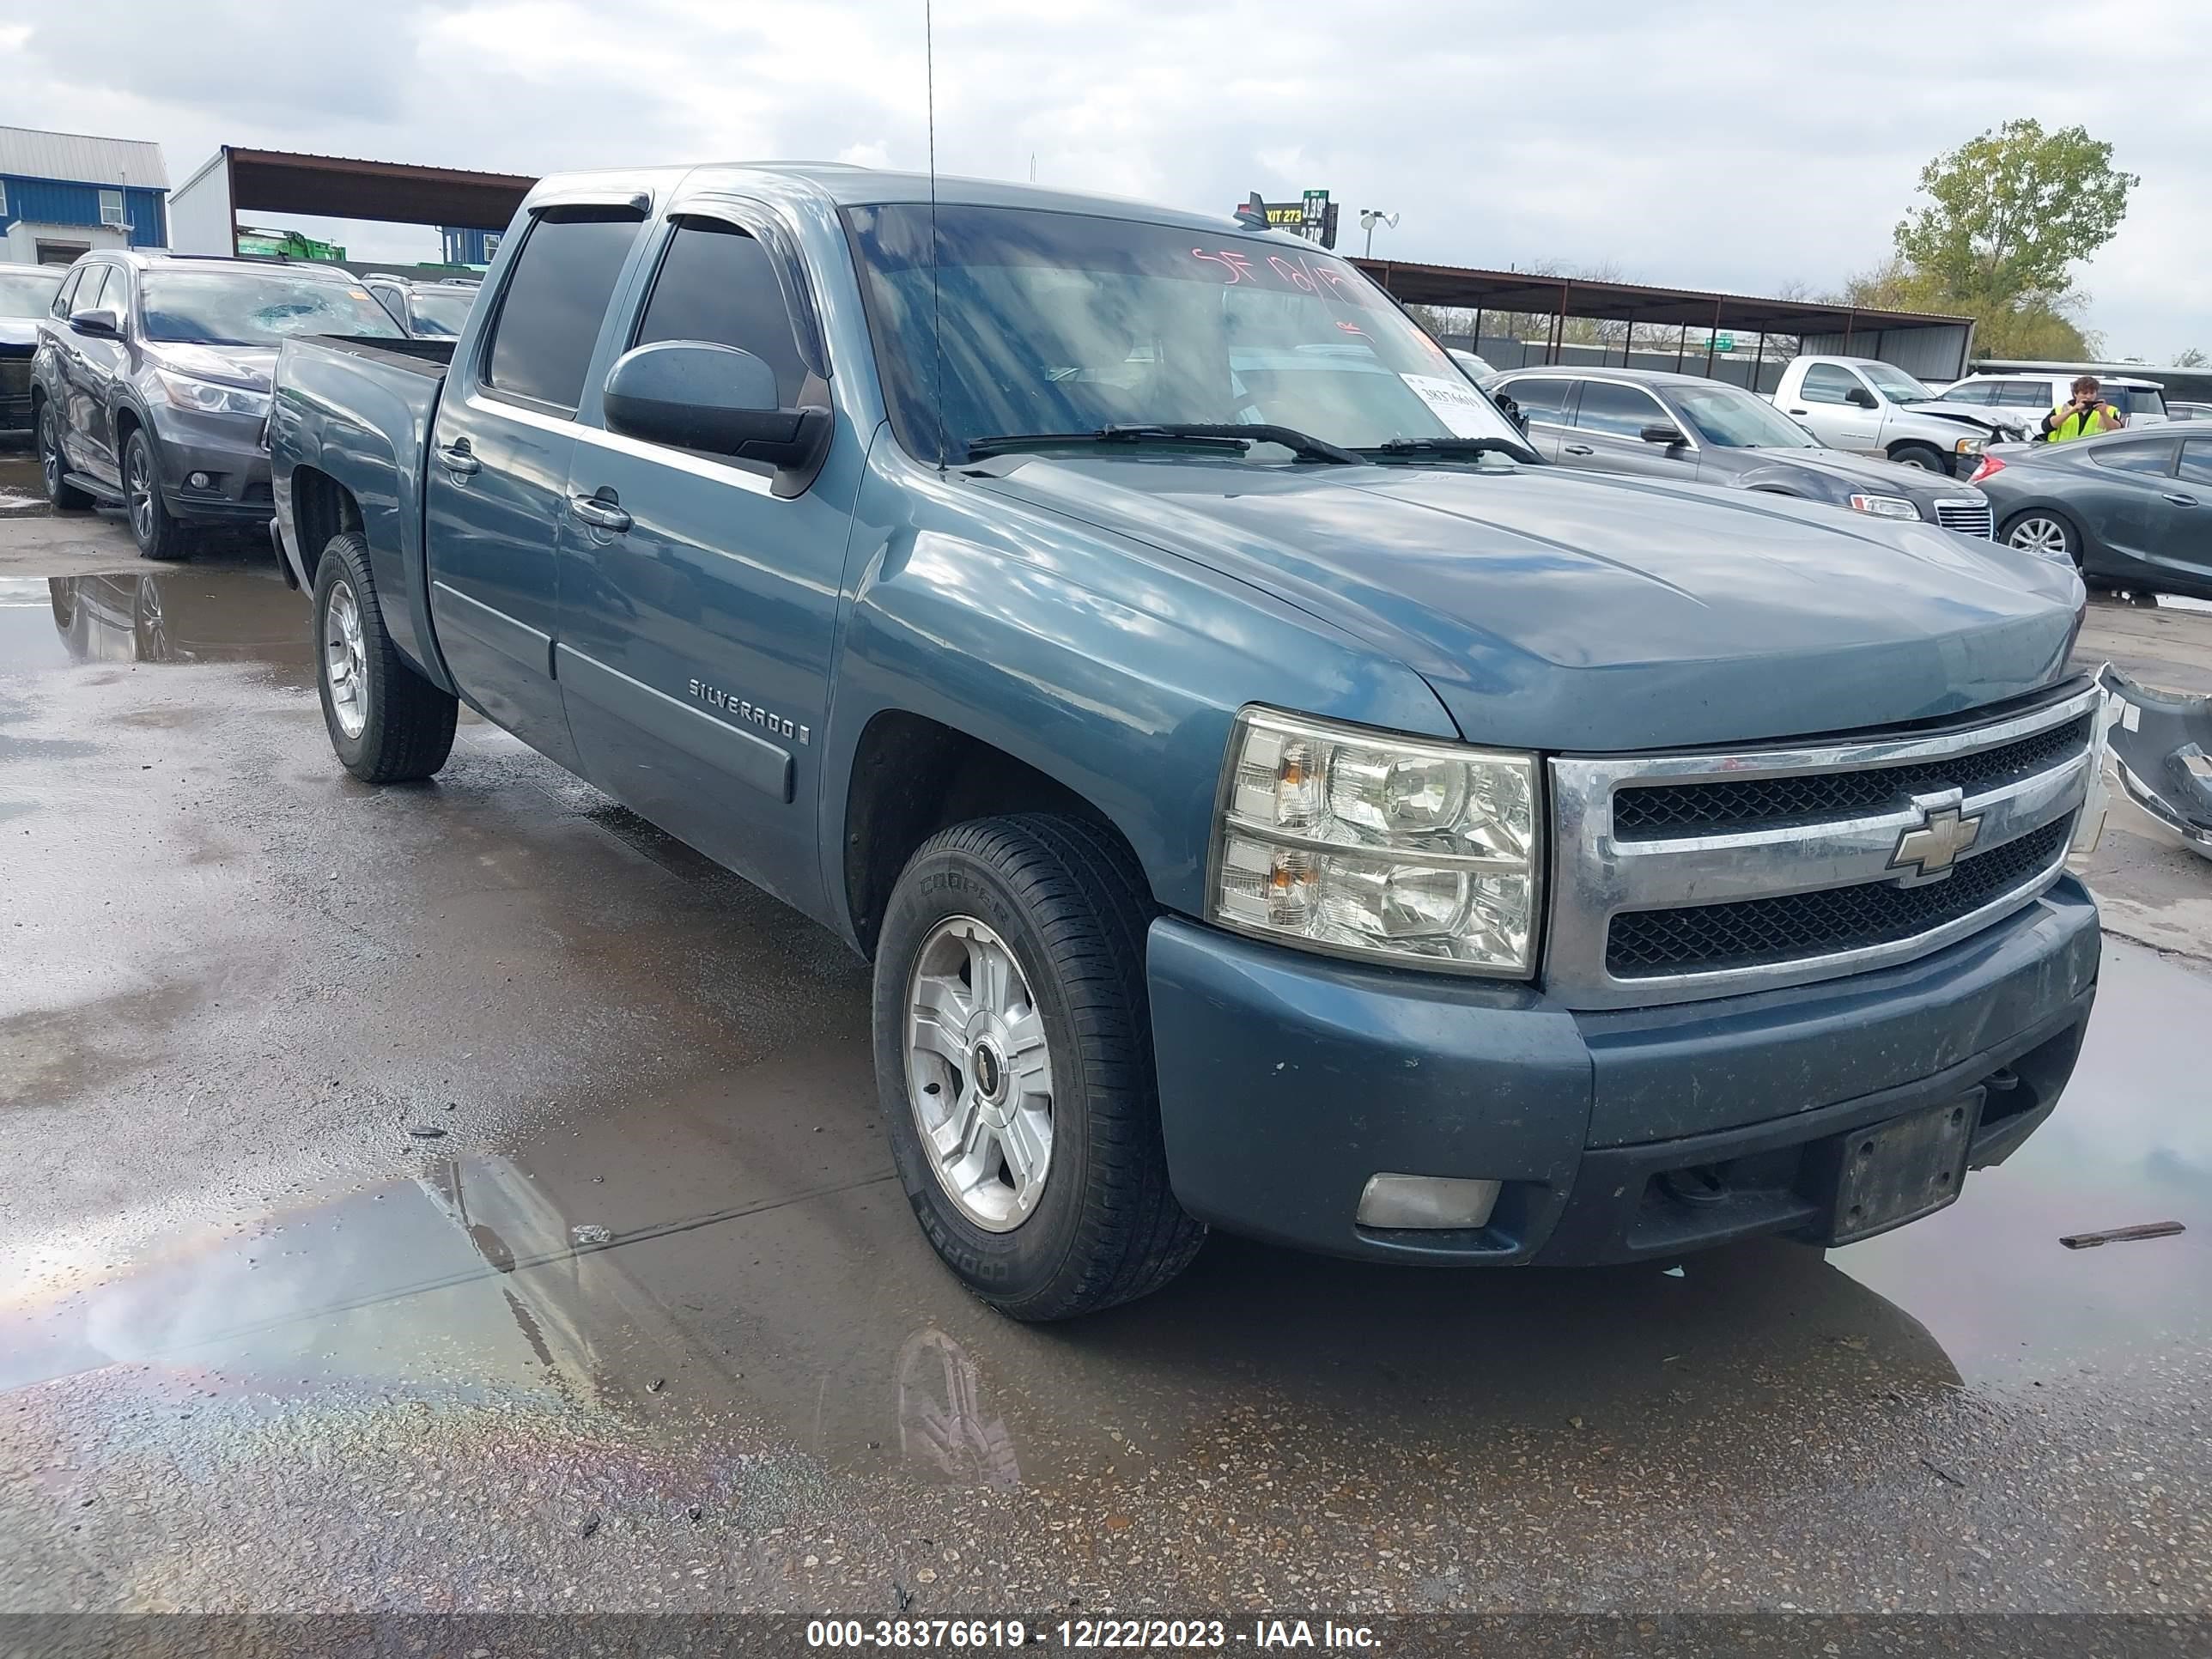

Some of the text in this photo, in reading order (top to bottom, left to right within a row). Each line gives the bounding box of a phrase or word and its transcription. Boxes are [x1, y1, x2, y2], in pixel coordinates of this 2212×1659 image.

[1267, 210, 1302, 223] XIT 273
[1421, 388, 1480, 410] 38376619
[689, 678, 795, 739] SILVERADO
[920, 872, 1011, 927] COOPER
[917, 1206, 1009, 1282] COOPER
